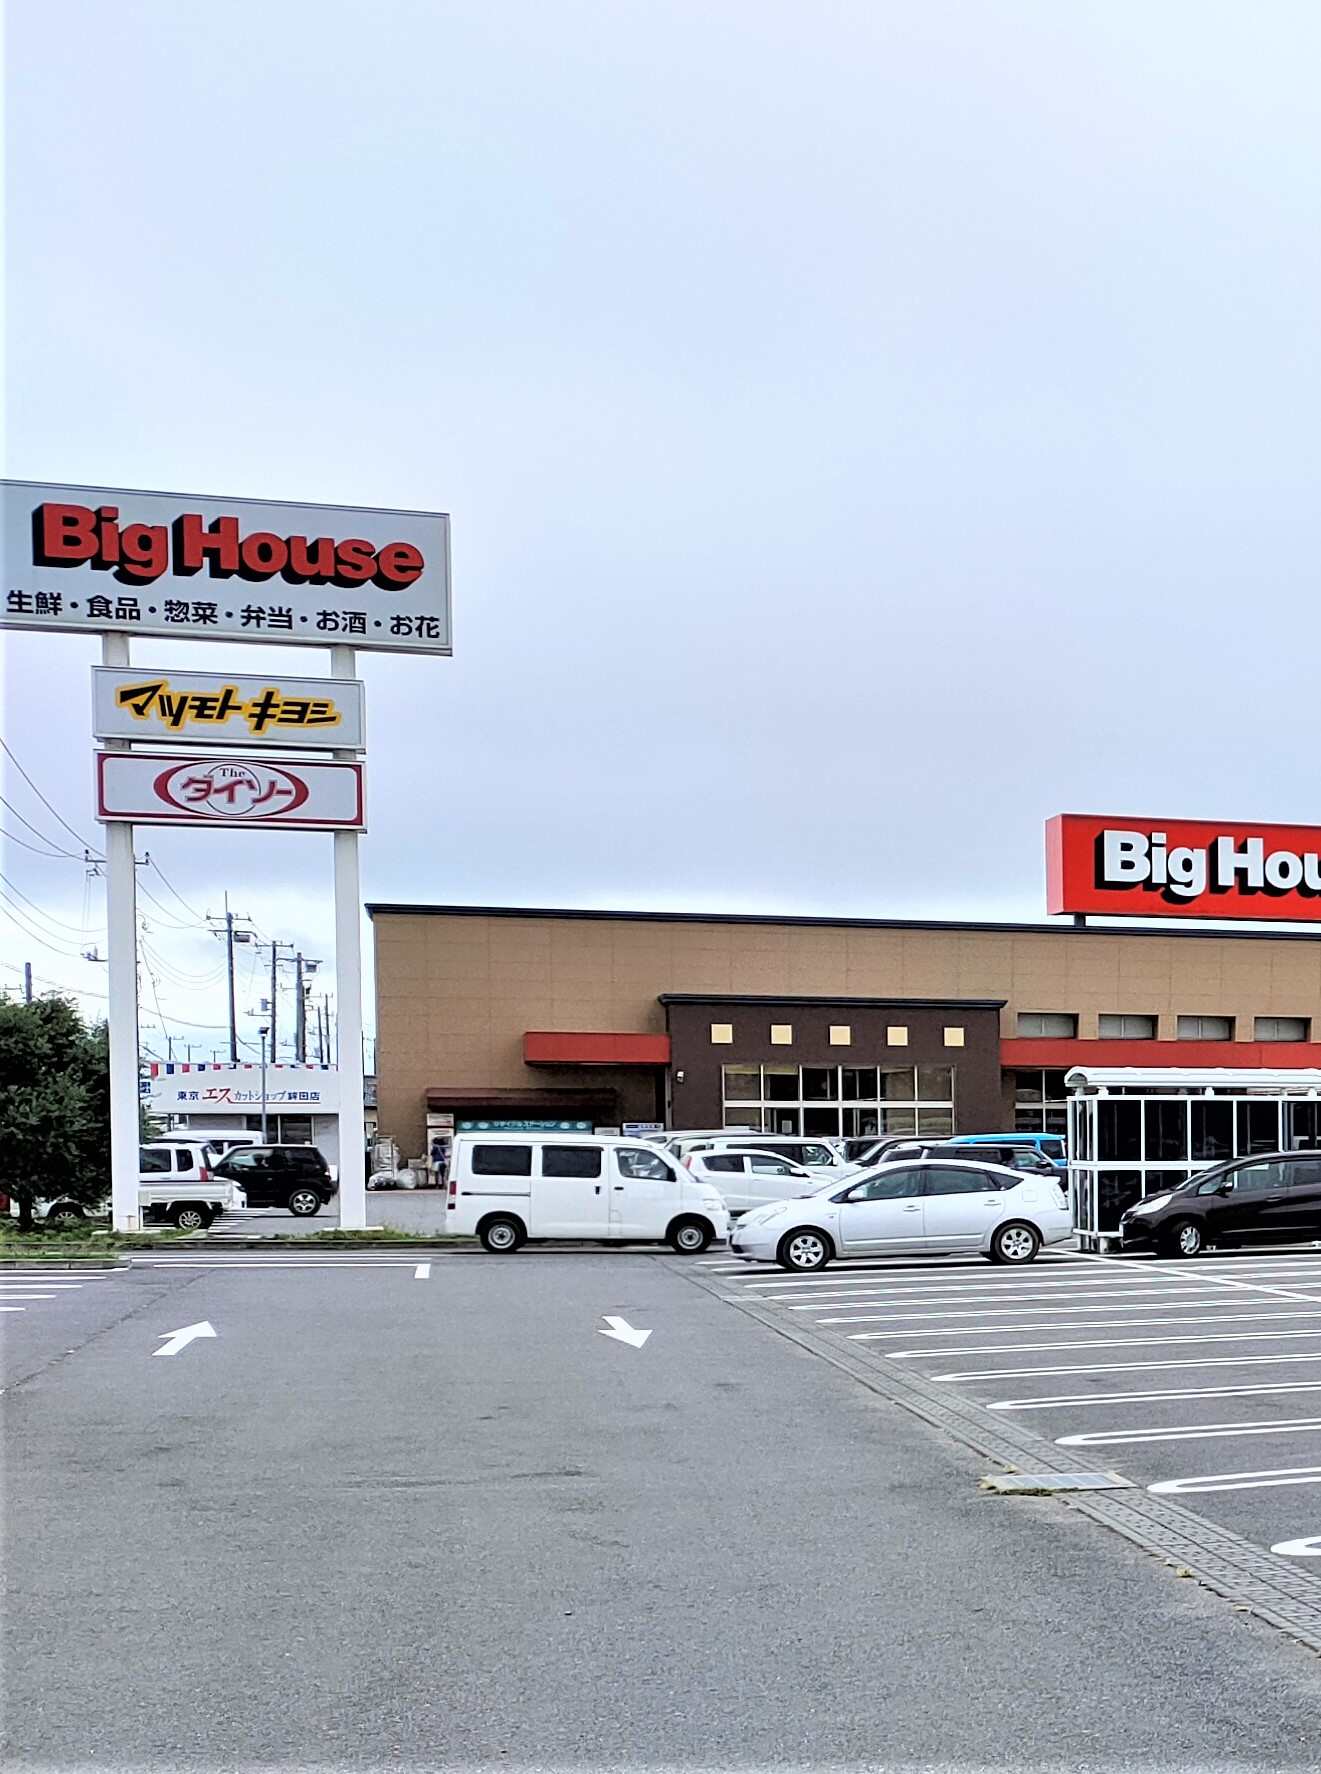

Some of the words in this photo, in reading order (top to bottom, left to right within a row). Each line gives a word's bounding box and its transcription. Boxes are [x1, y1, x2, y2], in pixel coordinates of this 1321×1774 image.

[33, 503, 168, 586] Big
[173, 514, 424, 591] House
[180, 774, 293, 804] ダイソー
[219, 767, 245, 778] The
[1095, 830, 1206, 904] Big
